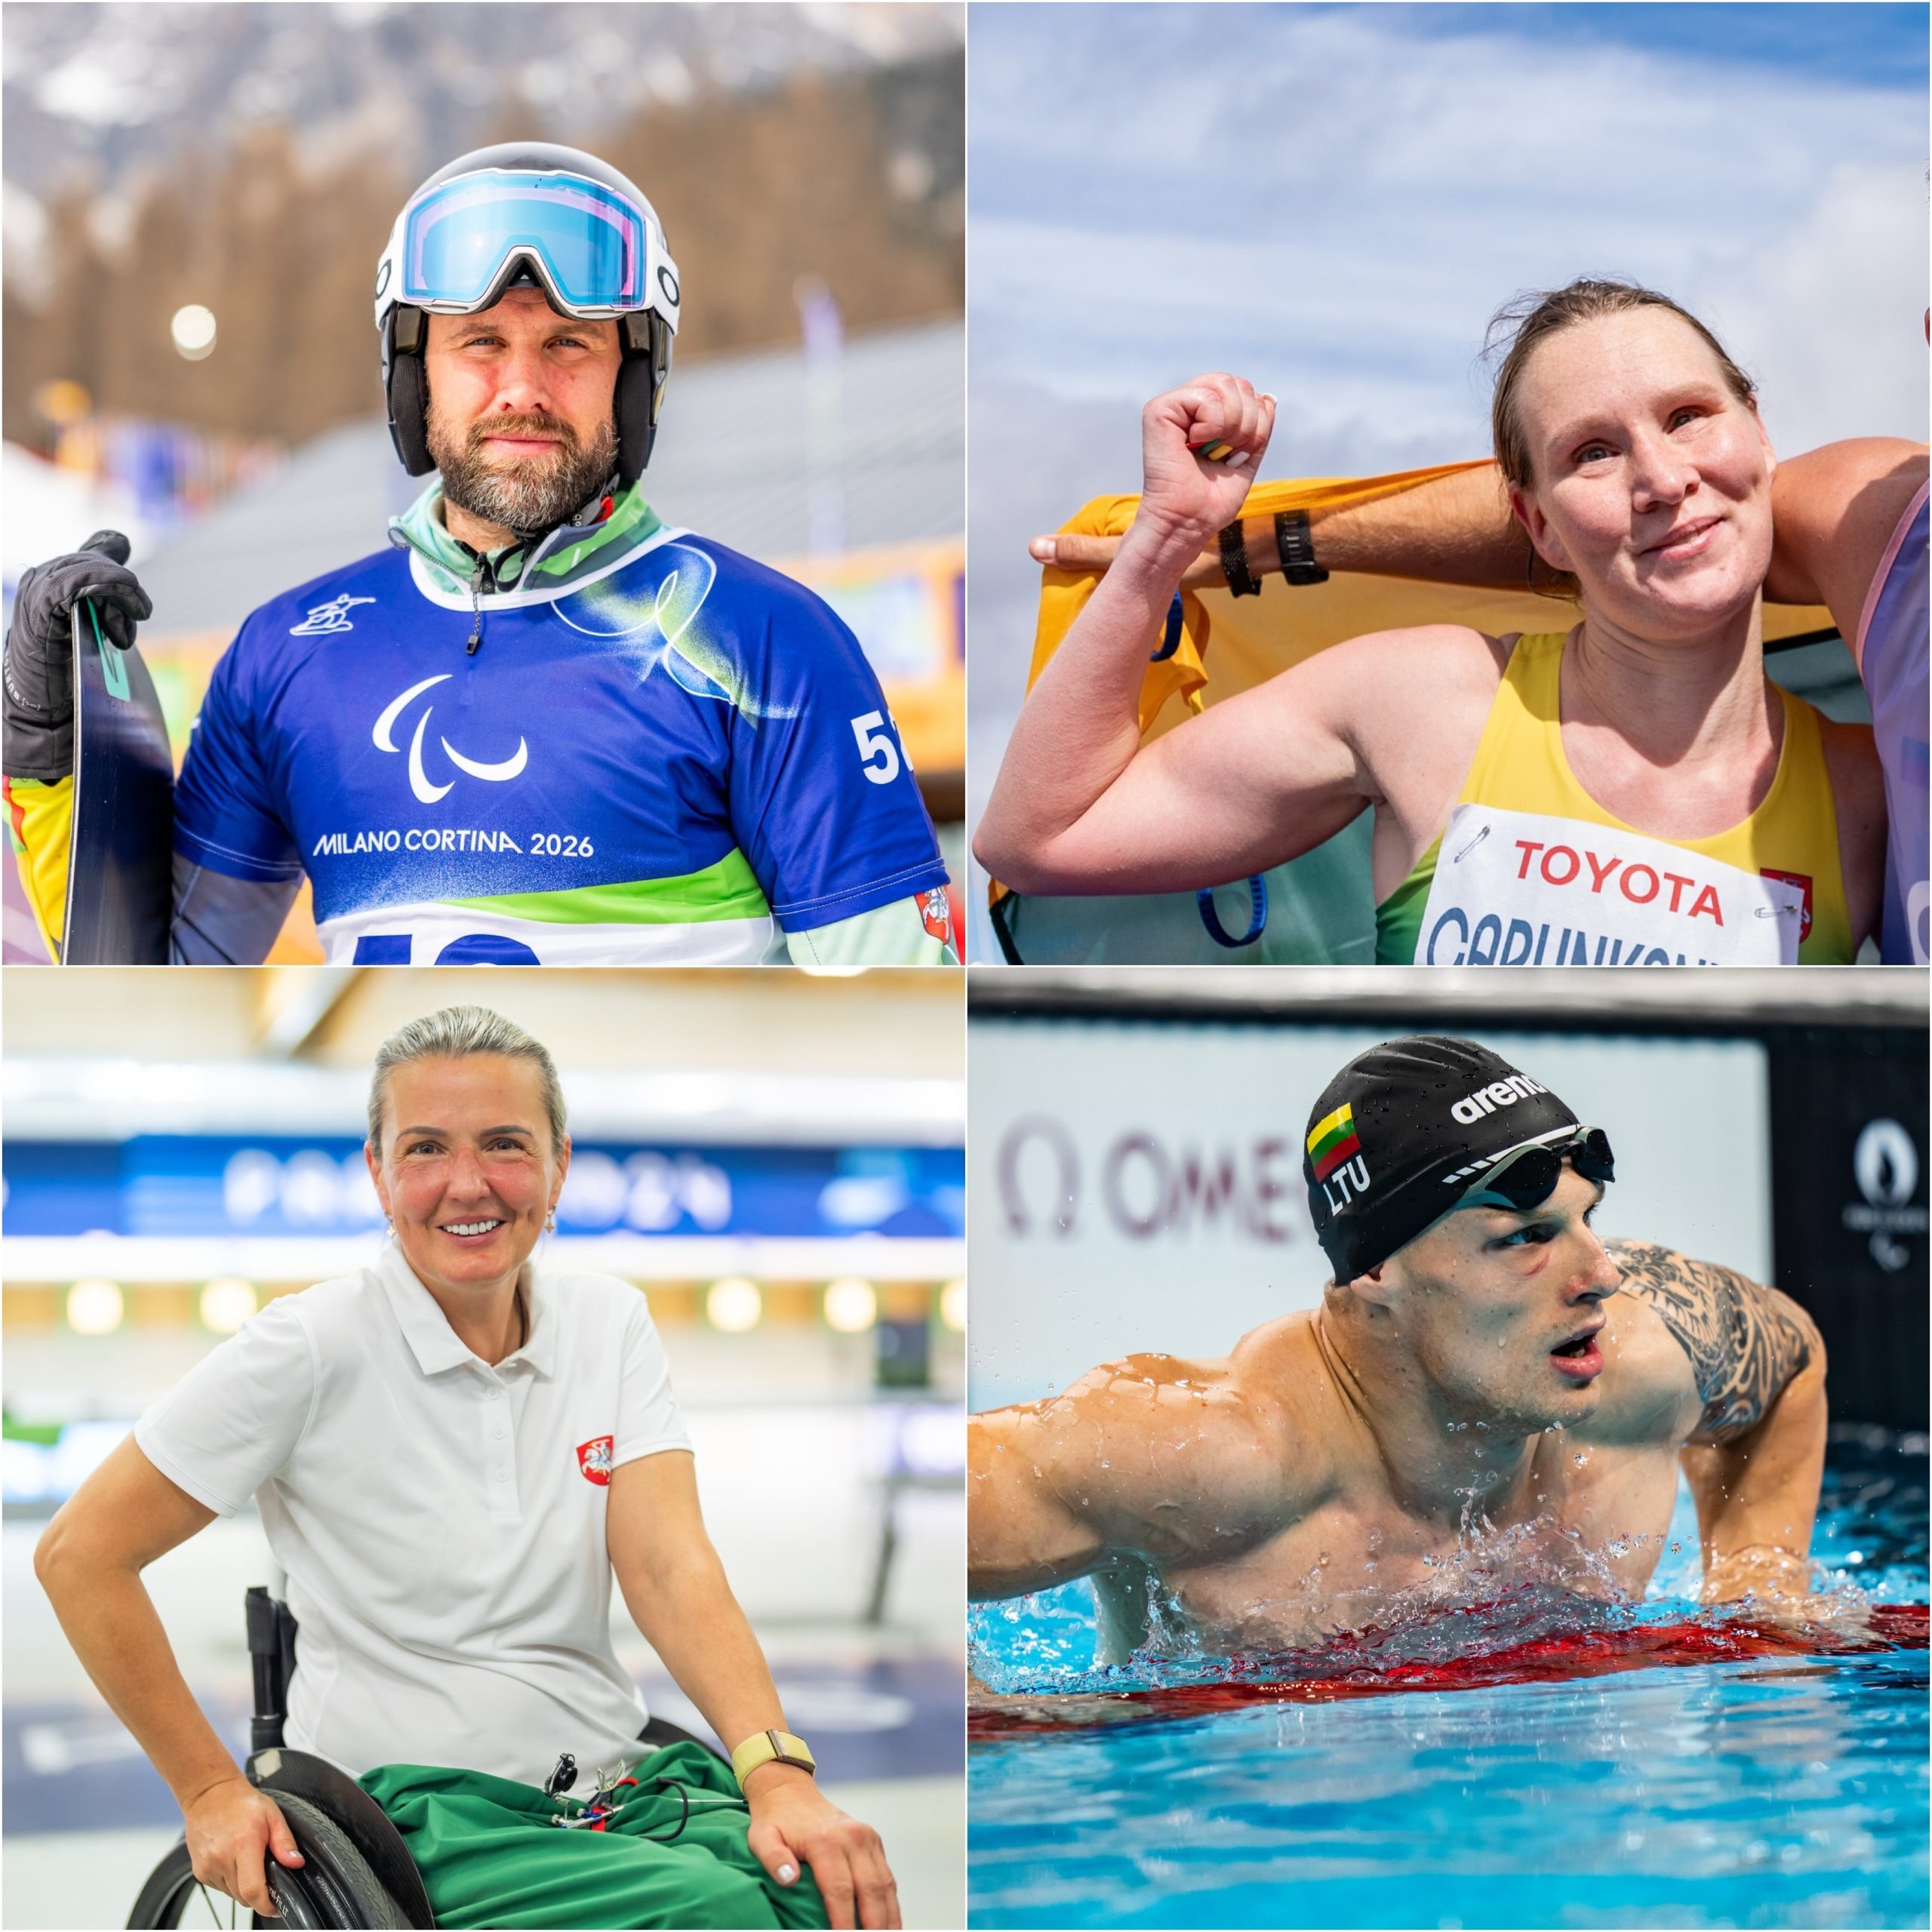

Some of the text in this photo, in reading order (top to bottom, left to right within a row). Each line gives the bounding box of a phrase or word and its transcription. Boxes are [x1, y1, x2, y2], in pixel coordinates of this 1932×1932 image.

[850, 709, 914, 784] 5
[312, 829, 594, 857] MILANO CORTINA 2026
[1515, 840, 1724, 927] TOYOTA
[1451, 1075, 1548, 1124] arena
[1101, 1126, 1298, 1247] OME
[1322, 1155, 1371, 1217] LTU
